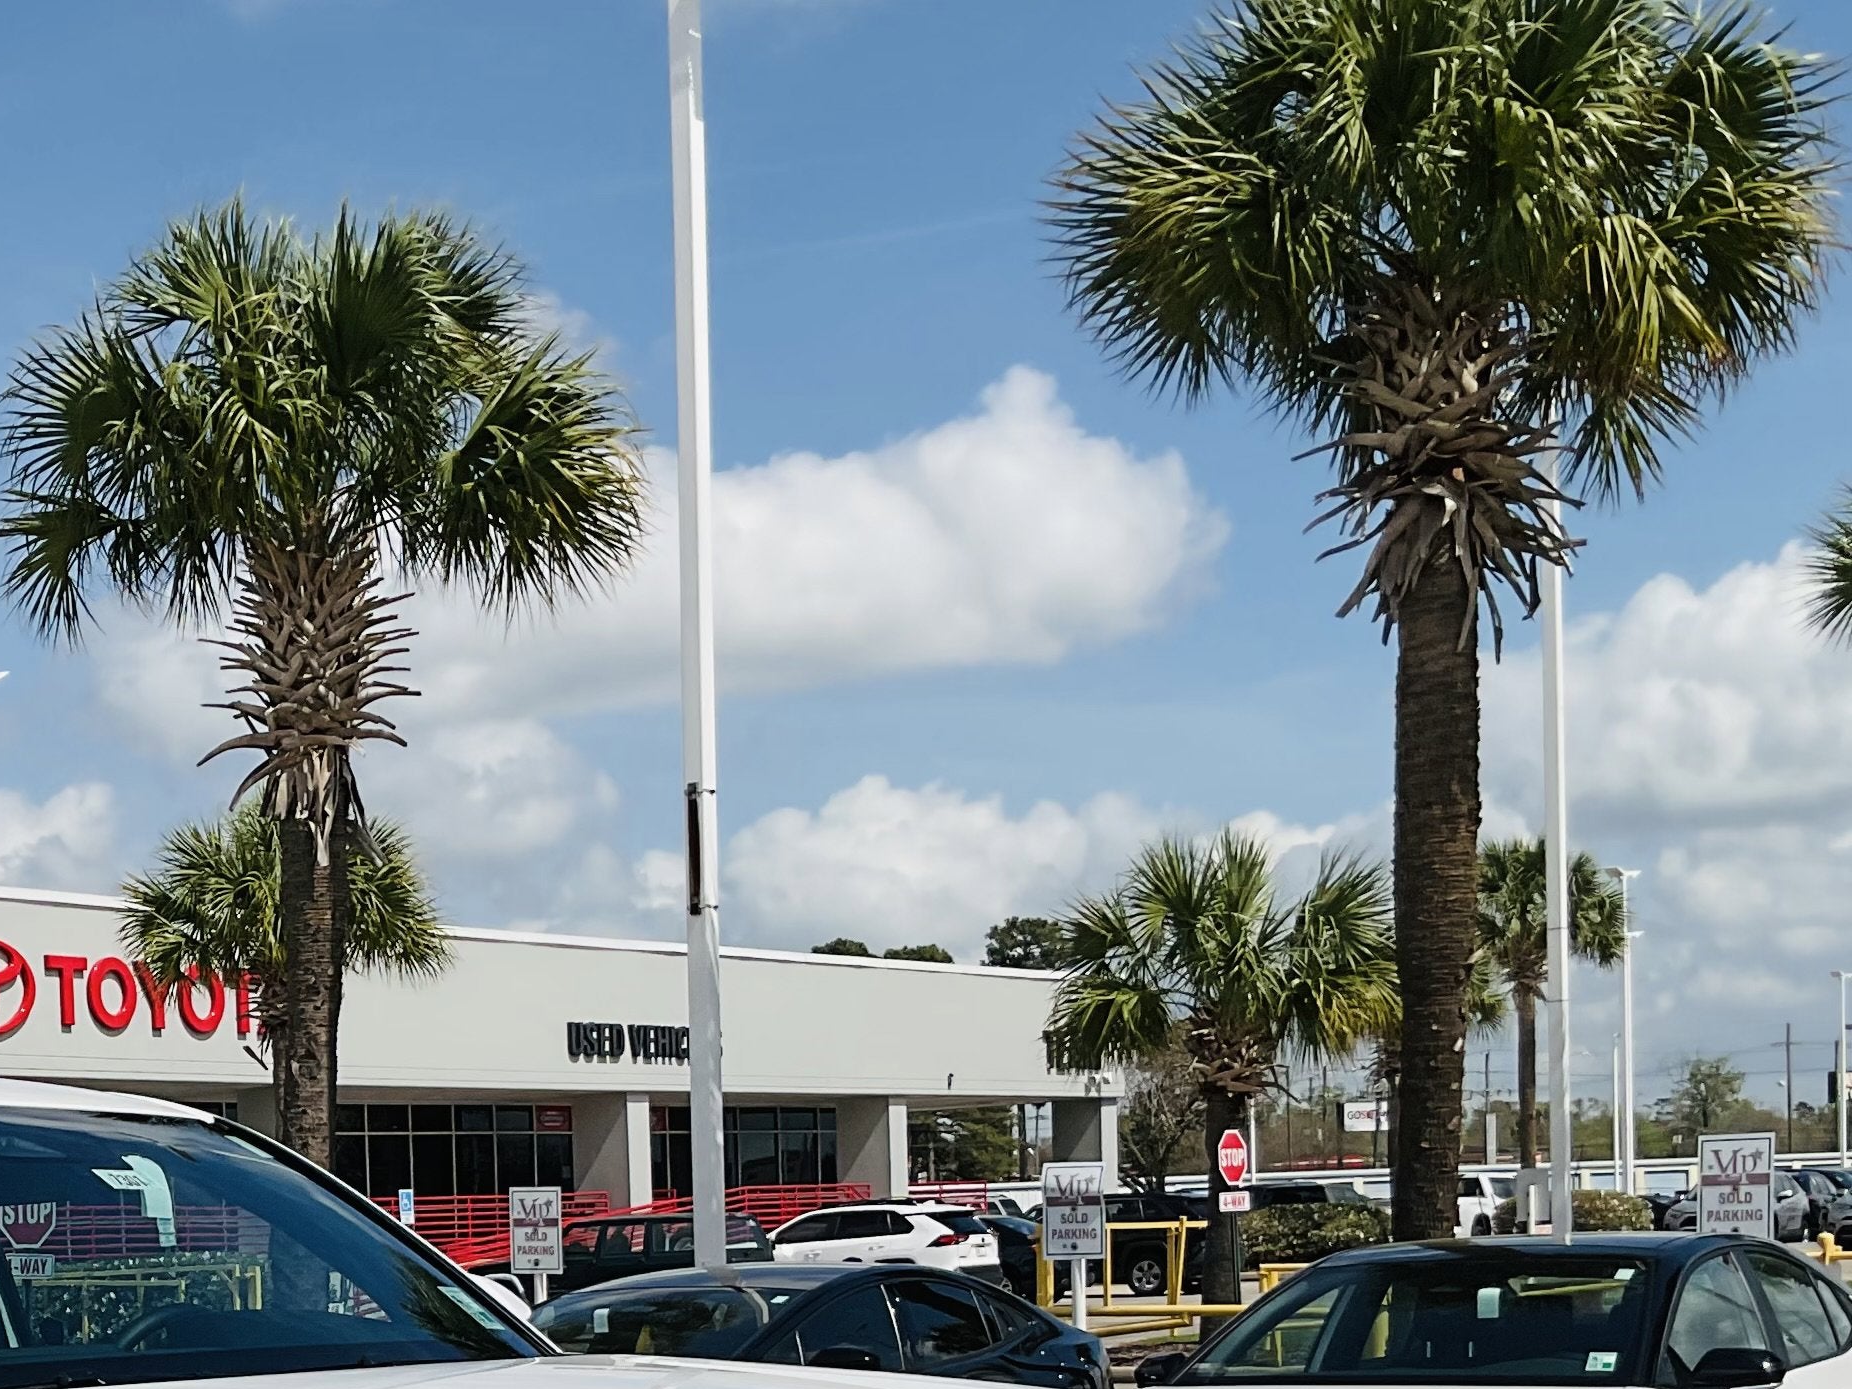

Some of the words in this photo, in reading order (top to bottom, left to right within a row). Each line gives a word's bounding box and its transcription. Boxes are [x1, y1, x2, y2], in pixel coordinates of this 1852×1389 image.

[44, 954, 265, 1034] TOYOT
[566, 1022, 625, 1059] USED
[627, 1024, 690, 1062] VEHIC
[1221, 1148, 1245, 1168] STOP
[1223, 1195, 1246, 1207] 4-WAY
[1718, 1191, 1753, 1204] SOLD
[3, 1203, 52, 1224] STOP
[1060, 1213, 1088, 1224] SOLD
[1707, 1209, 1763, 1222] PARKING
[524, 1231, 548, 1242] SOLD
[1052, 1229, 1097, 1240] PARKING
[517, 1245, 555, 1256] PARKING
[11, 1258, 48, 1275] -WAY
